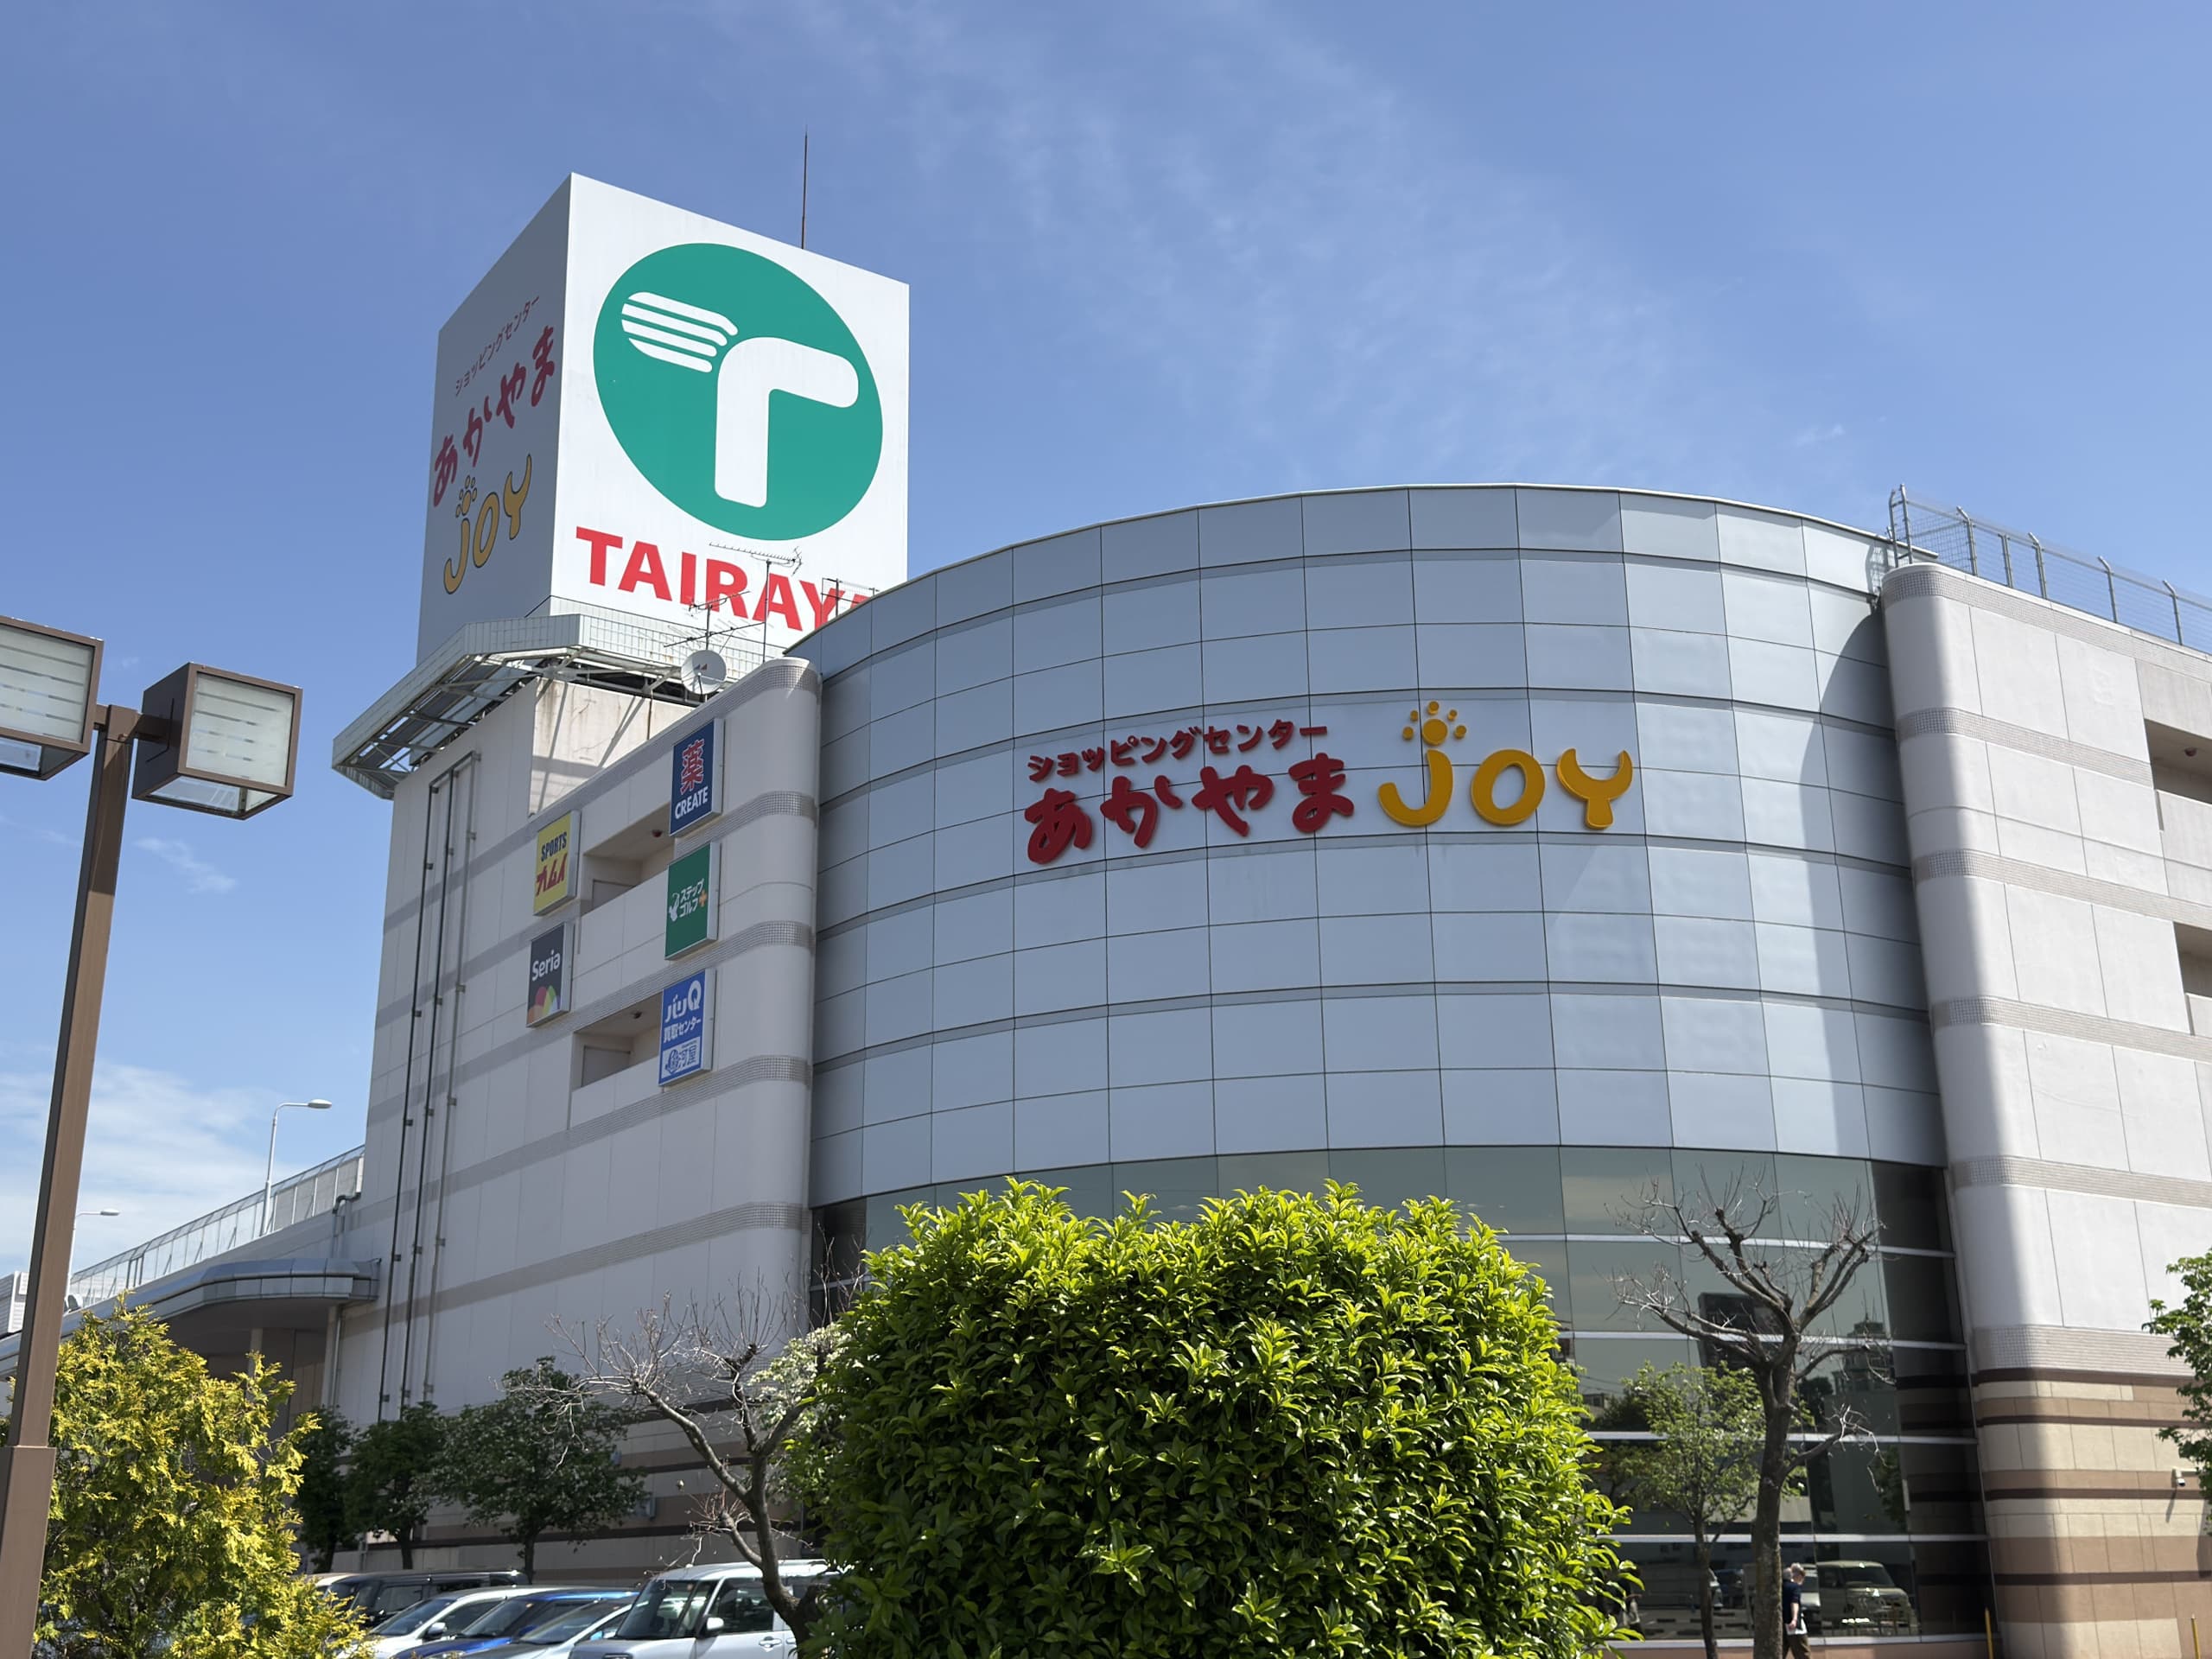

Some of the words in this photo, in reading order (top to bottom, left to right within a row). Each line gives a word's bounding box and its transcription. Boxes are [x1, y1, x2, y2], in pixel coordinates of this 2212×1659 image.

[455, 296, 540, 397] ショッピングセンター
[434, 325, 556, 508] あかやま
[575, 525, 873, 631] TAIRAY
[680, 738, 705, 795] 薬
[1027, 719, 1328, 783] ショッピングセンター
[675, 785, 709, 820] CREATE
[1024, 752, 1355, 864] あかやま
[541, 831, 567, 862] SPORTS
[679, 898, 698, 918] ゴルフ
[680, 878, 704, 904] ステップ
[531, 950, 561, 982] Seria
